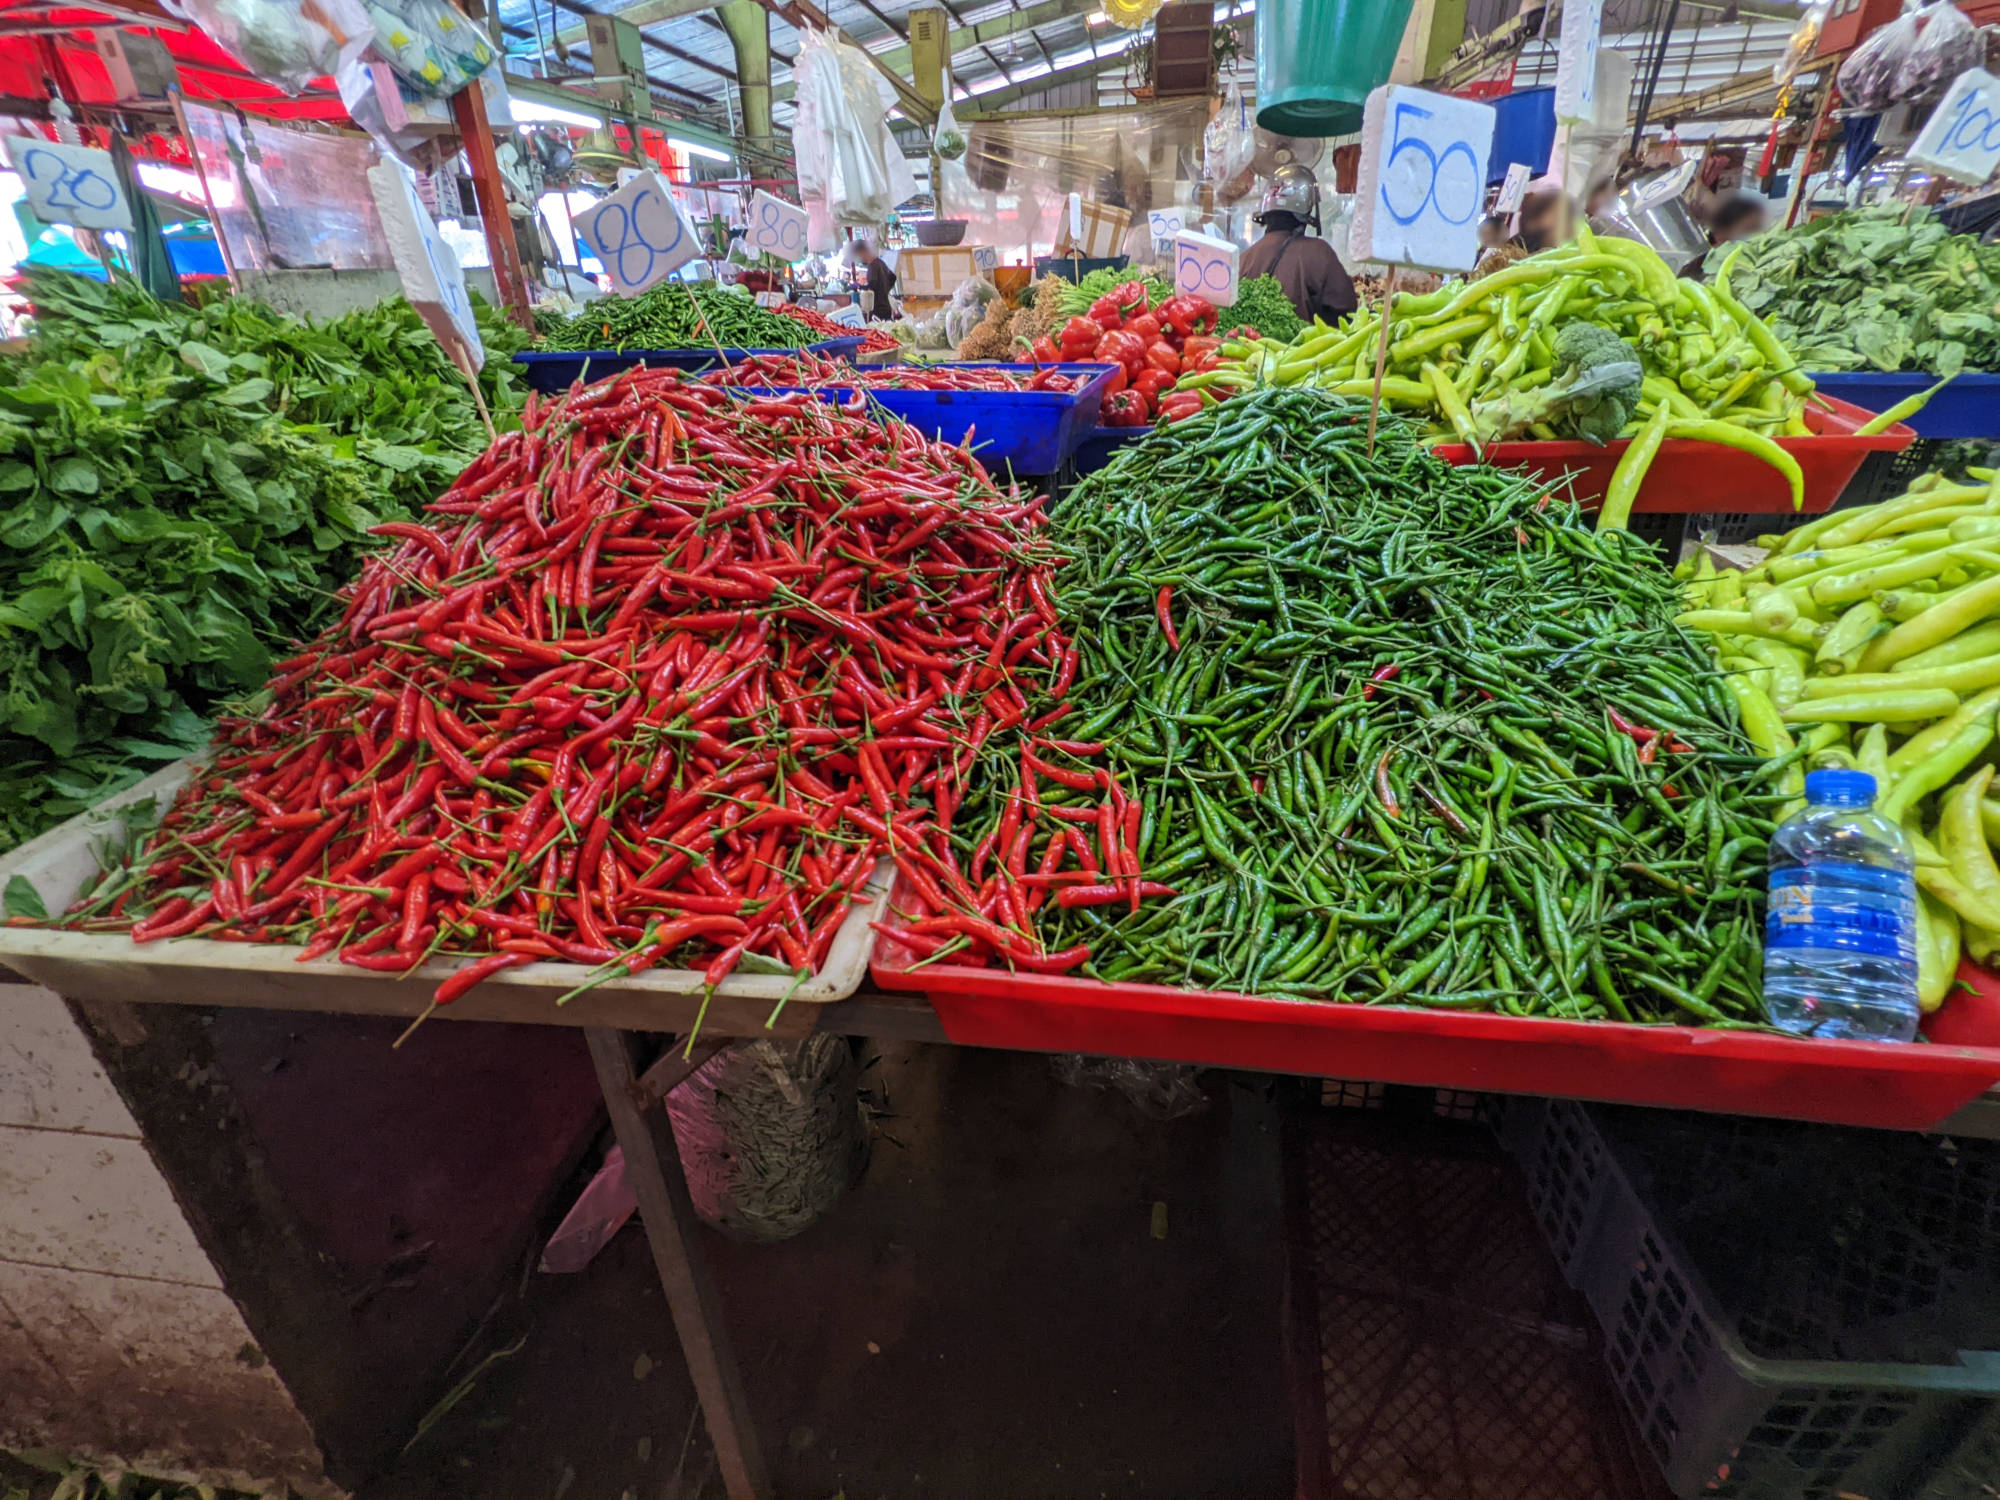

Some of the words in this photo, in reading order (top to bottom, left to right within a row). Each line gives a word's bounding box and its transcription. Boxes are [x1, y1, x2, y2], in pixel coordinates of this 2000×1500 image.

[24, 148, 117, 210] 20
[1381, 102, 1479, 226] 50
[593, 189, 682, 287] 80
[756, 202, 801, 250] 80
[1149, 212, 1182, 236] 30
[973, 248, 995, 269] 90
[1177, 242, 1232, 292] 50
